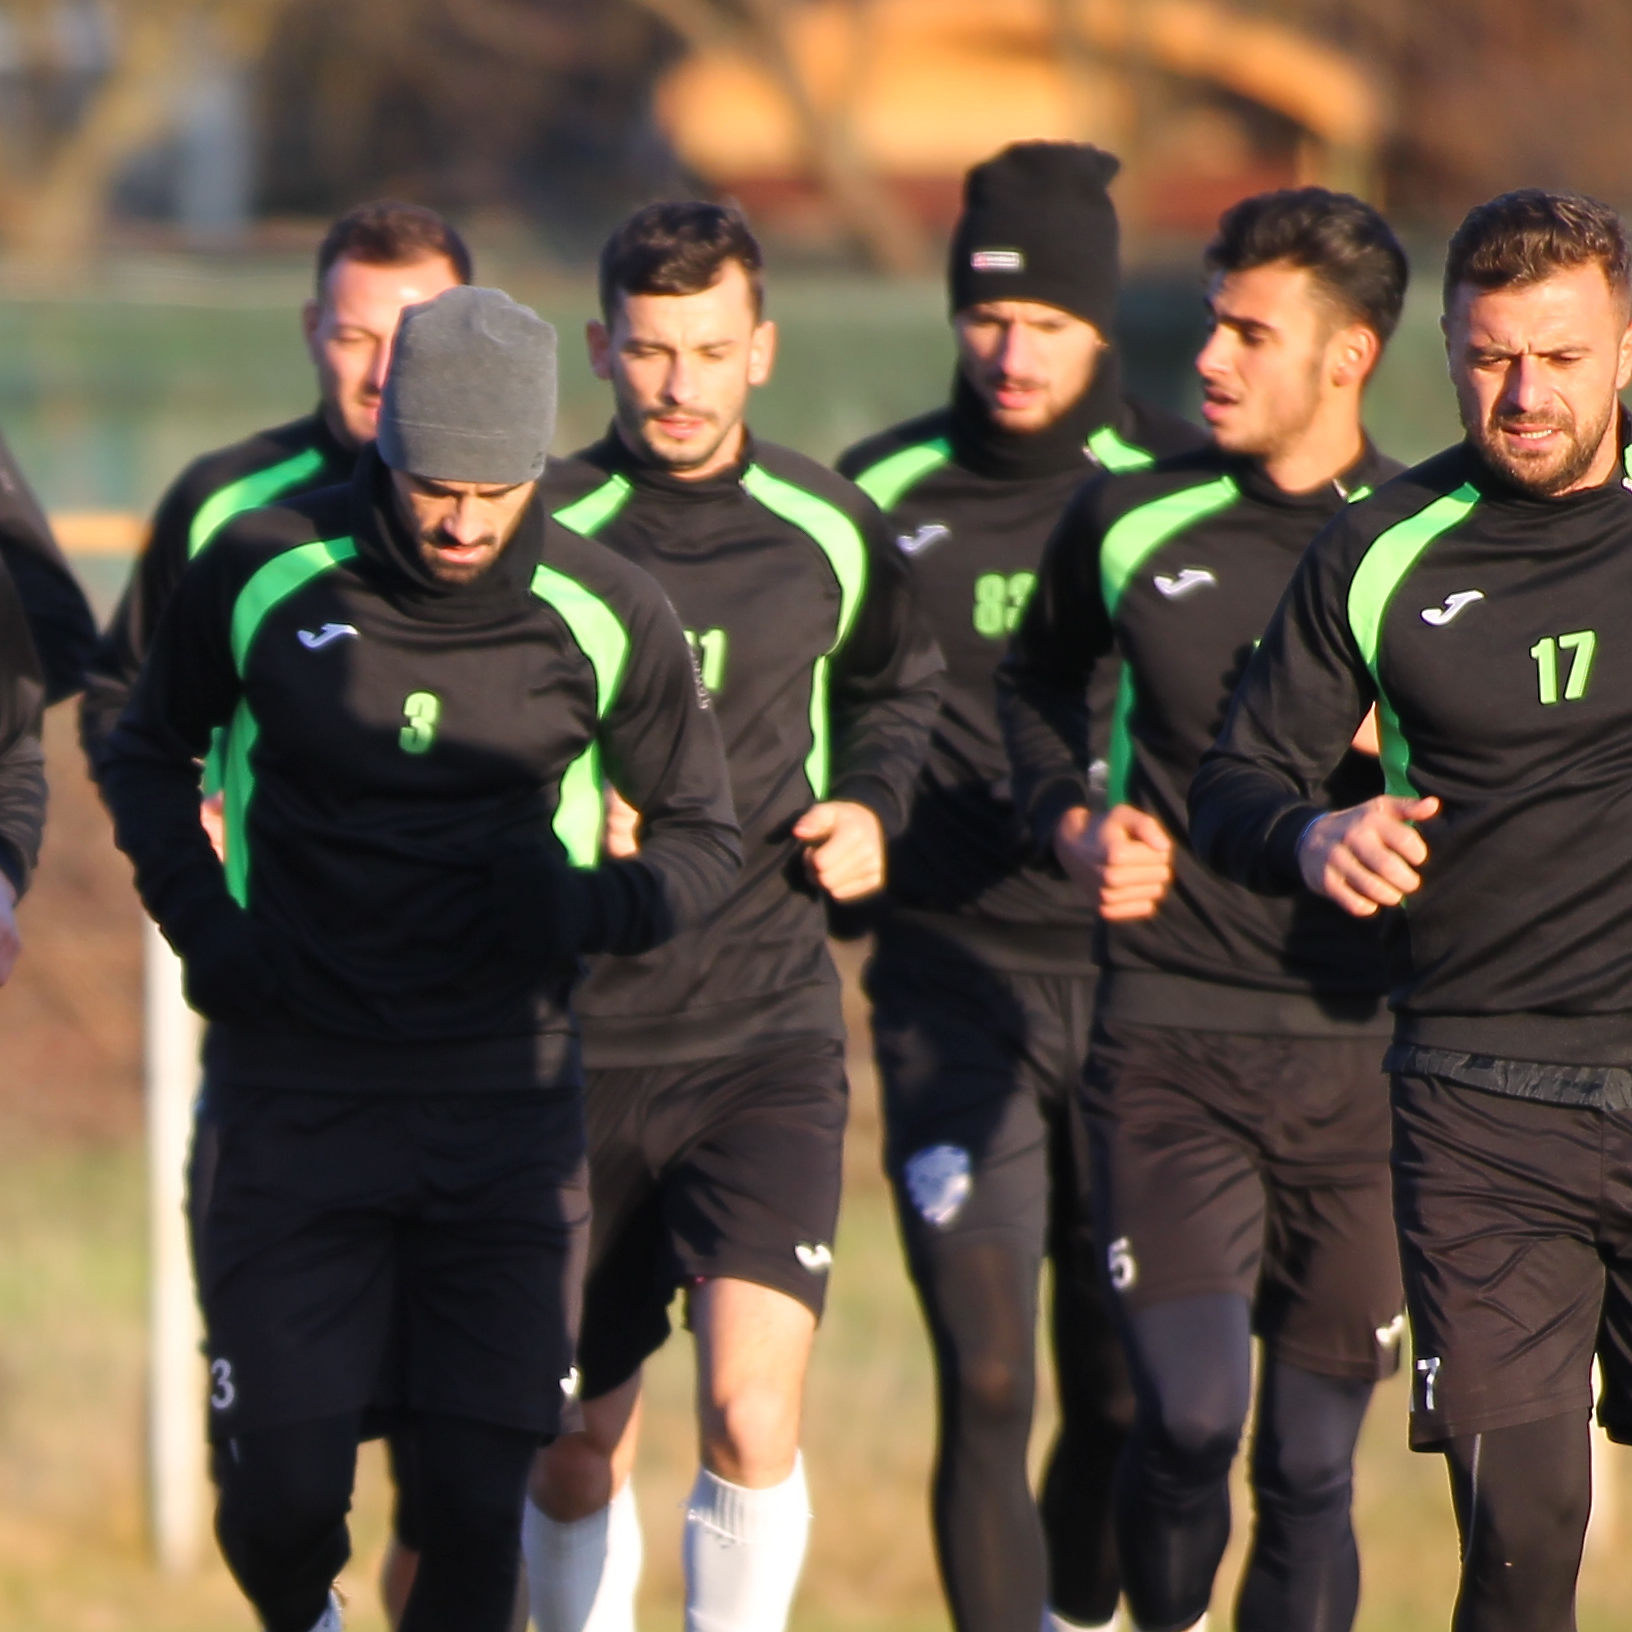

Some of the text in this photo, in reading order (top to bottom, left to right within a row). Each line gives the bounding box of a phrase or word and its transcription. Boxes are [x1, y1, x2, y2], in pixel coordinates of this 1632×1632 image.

[683, 629, 726, 693] 1
[1531, 629, 1597, 705] 17
[398, 691, 439, 755] 3
[1108, 1237, 1135, 1290] 5
[211, 1358, 235, 1410] 3
